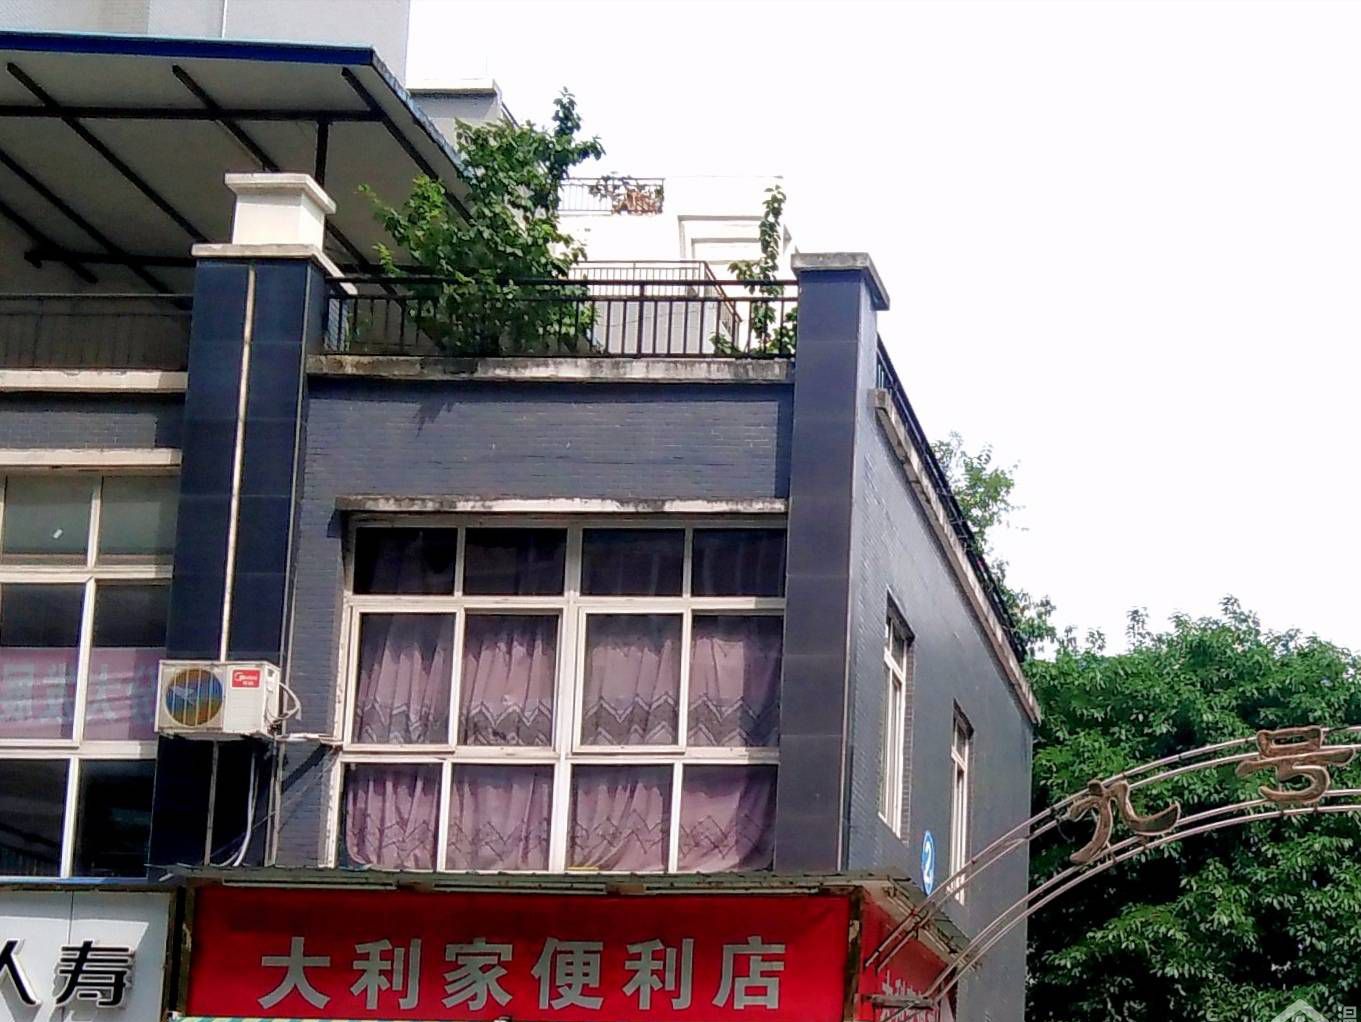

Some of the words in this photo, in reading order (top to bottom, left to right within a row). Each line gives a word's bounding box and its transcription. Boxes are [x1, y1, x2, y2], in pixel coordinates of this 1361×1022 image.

[257, 935, 787, 1010] 大利家便利店
